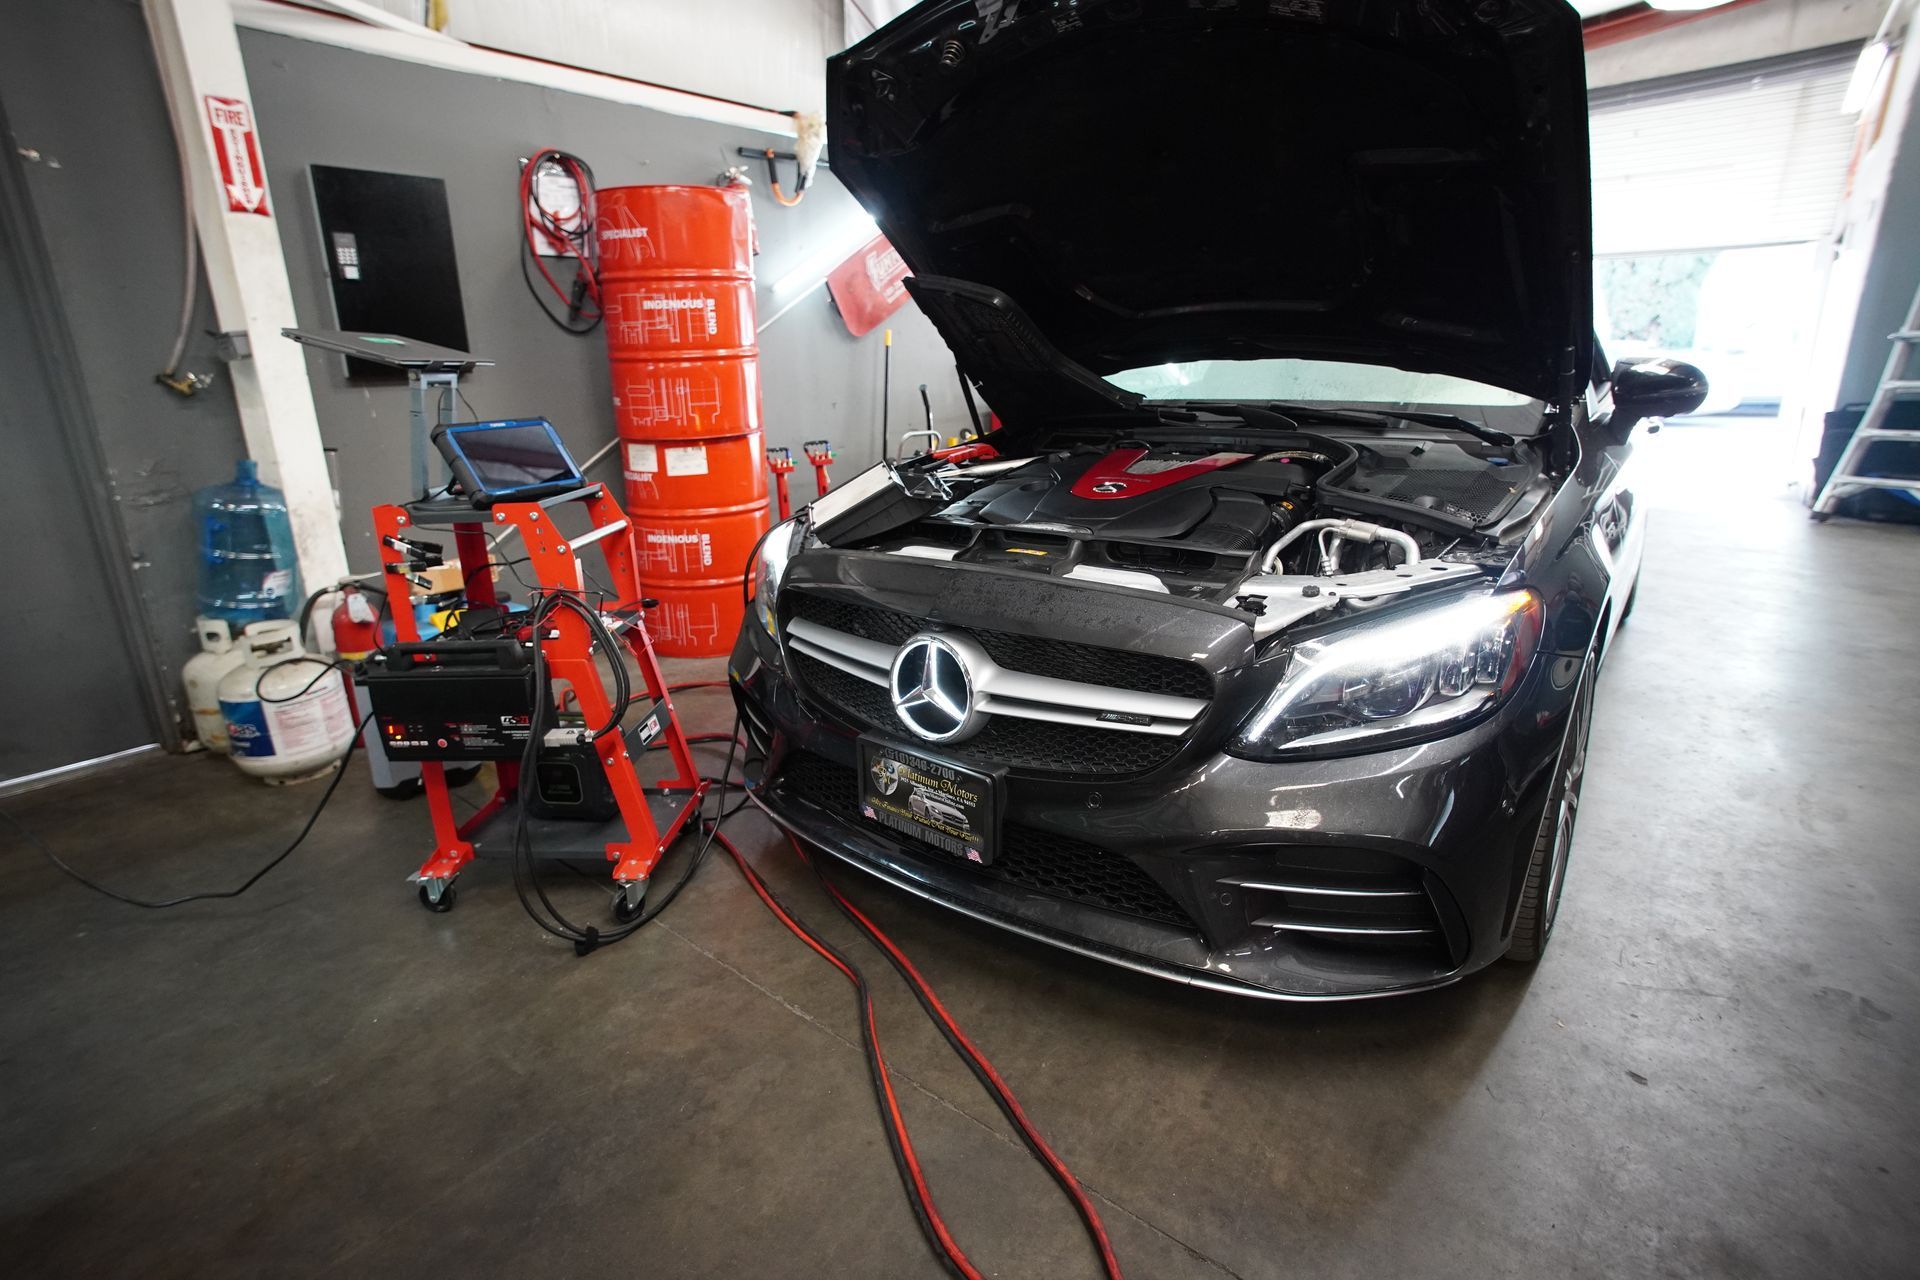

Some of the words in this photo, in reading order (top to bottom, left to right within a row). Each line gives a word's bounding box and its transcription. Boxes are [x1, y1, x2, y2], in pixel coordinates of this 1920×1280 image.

[214, 107, 245, 127] FIRE
[602, 227, 648, 240] SPECIALIST
[643, 299, 704, 310] INGENIOUS
[706, 298, 718, 335] BLEND
[647, 533, 699, 544] INGENIOUS
[702, 533, 712, 566] BLEND
[898, 764, 939, 789] Platinum
[941, 779, 978, 803] Motors
[879, 811, 921, 839] PLATINUM
[924, 830, 964, 857] MOTORS
